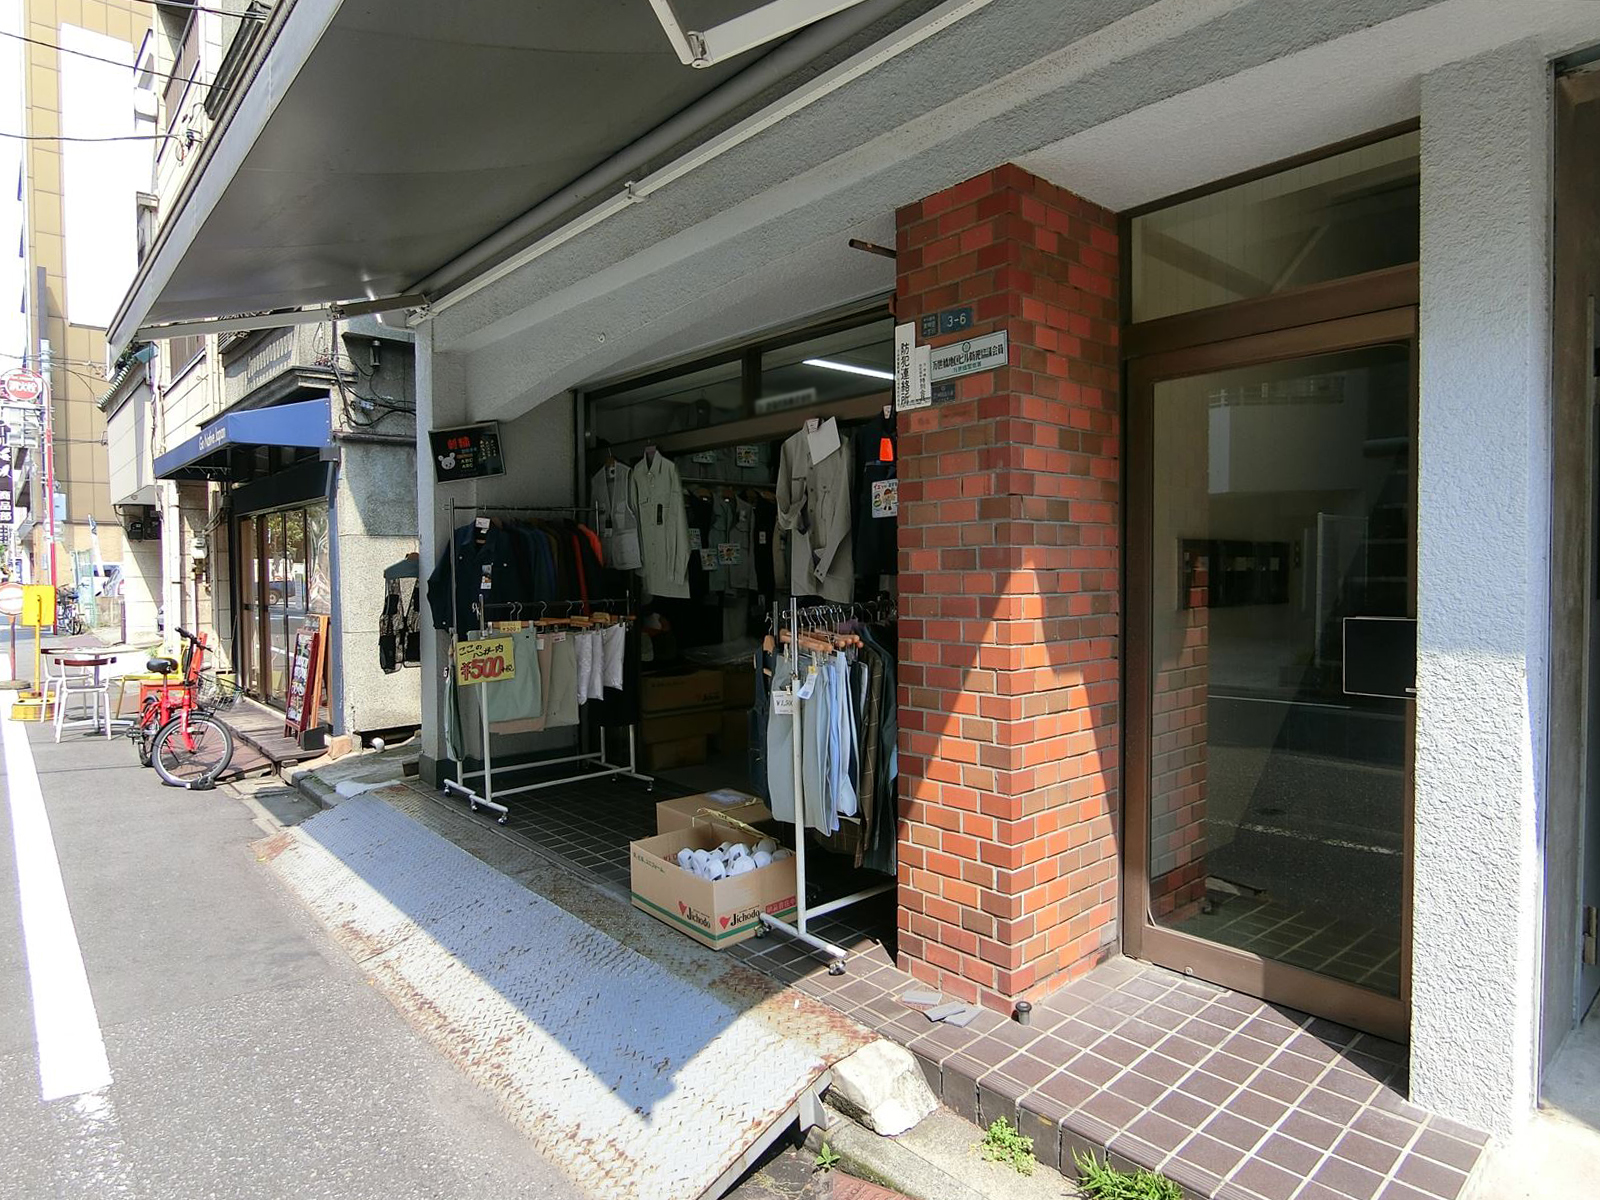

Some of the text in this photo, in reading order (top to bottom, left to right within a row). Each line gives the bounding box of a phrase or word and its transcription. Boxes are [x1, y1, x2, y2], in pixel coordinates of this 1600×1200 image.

[947, 313, 966, 328] 3-6
[458, 644, 483, 656] ここの
[686, 906, 711, 929] Jichodo
[730, 909, 760, 926] Jichodo
